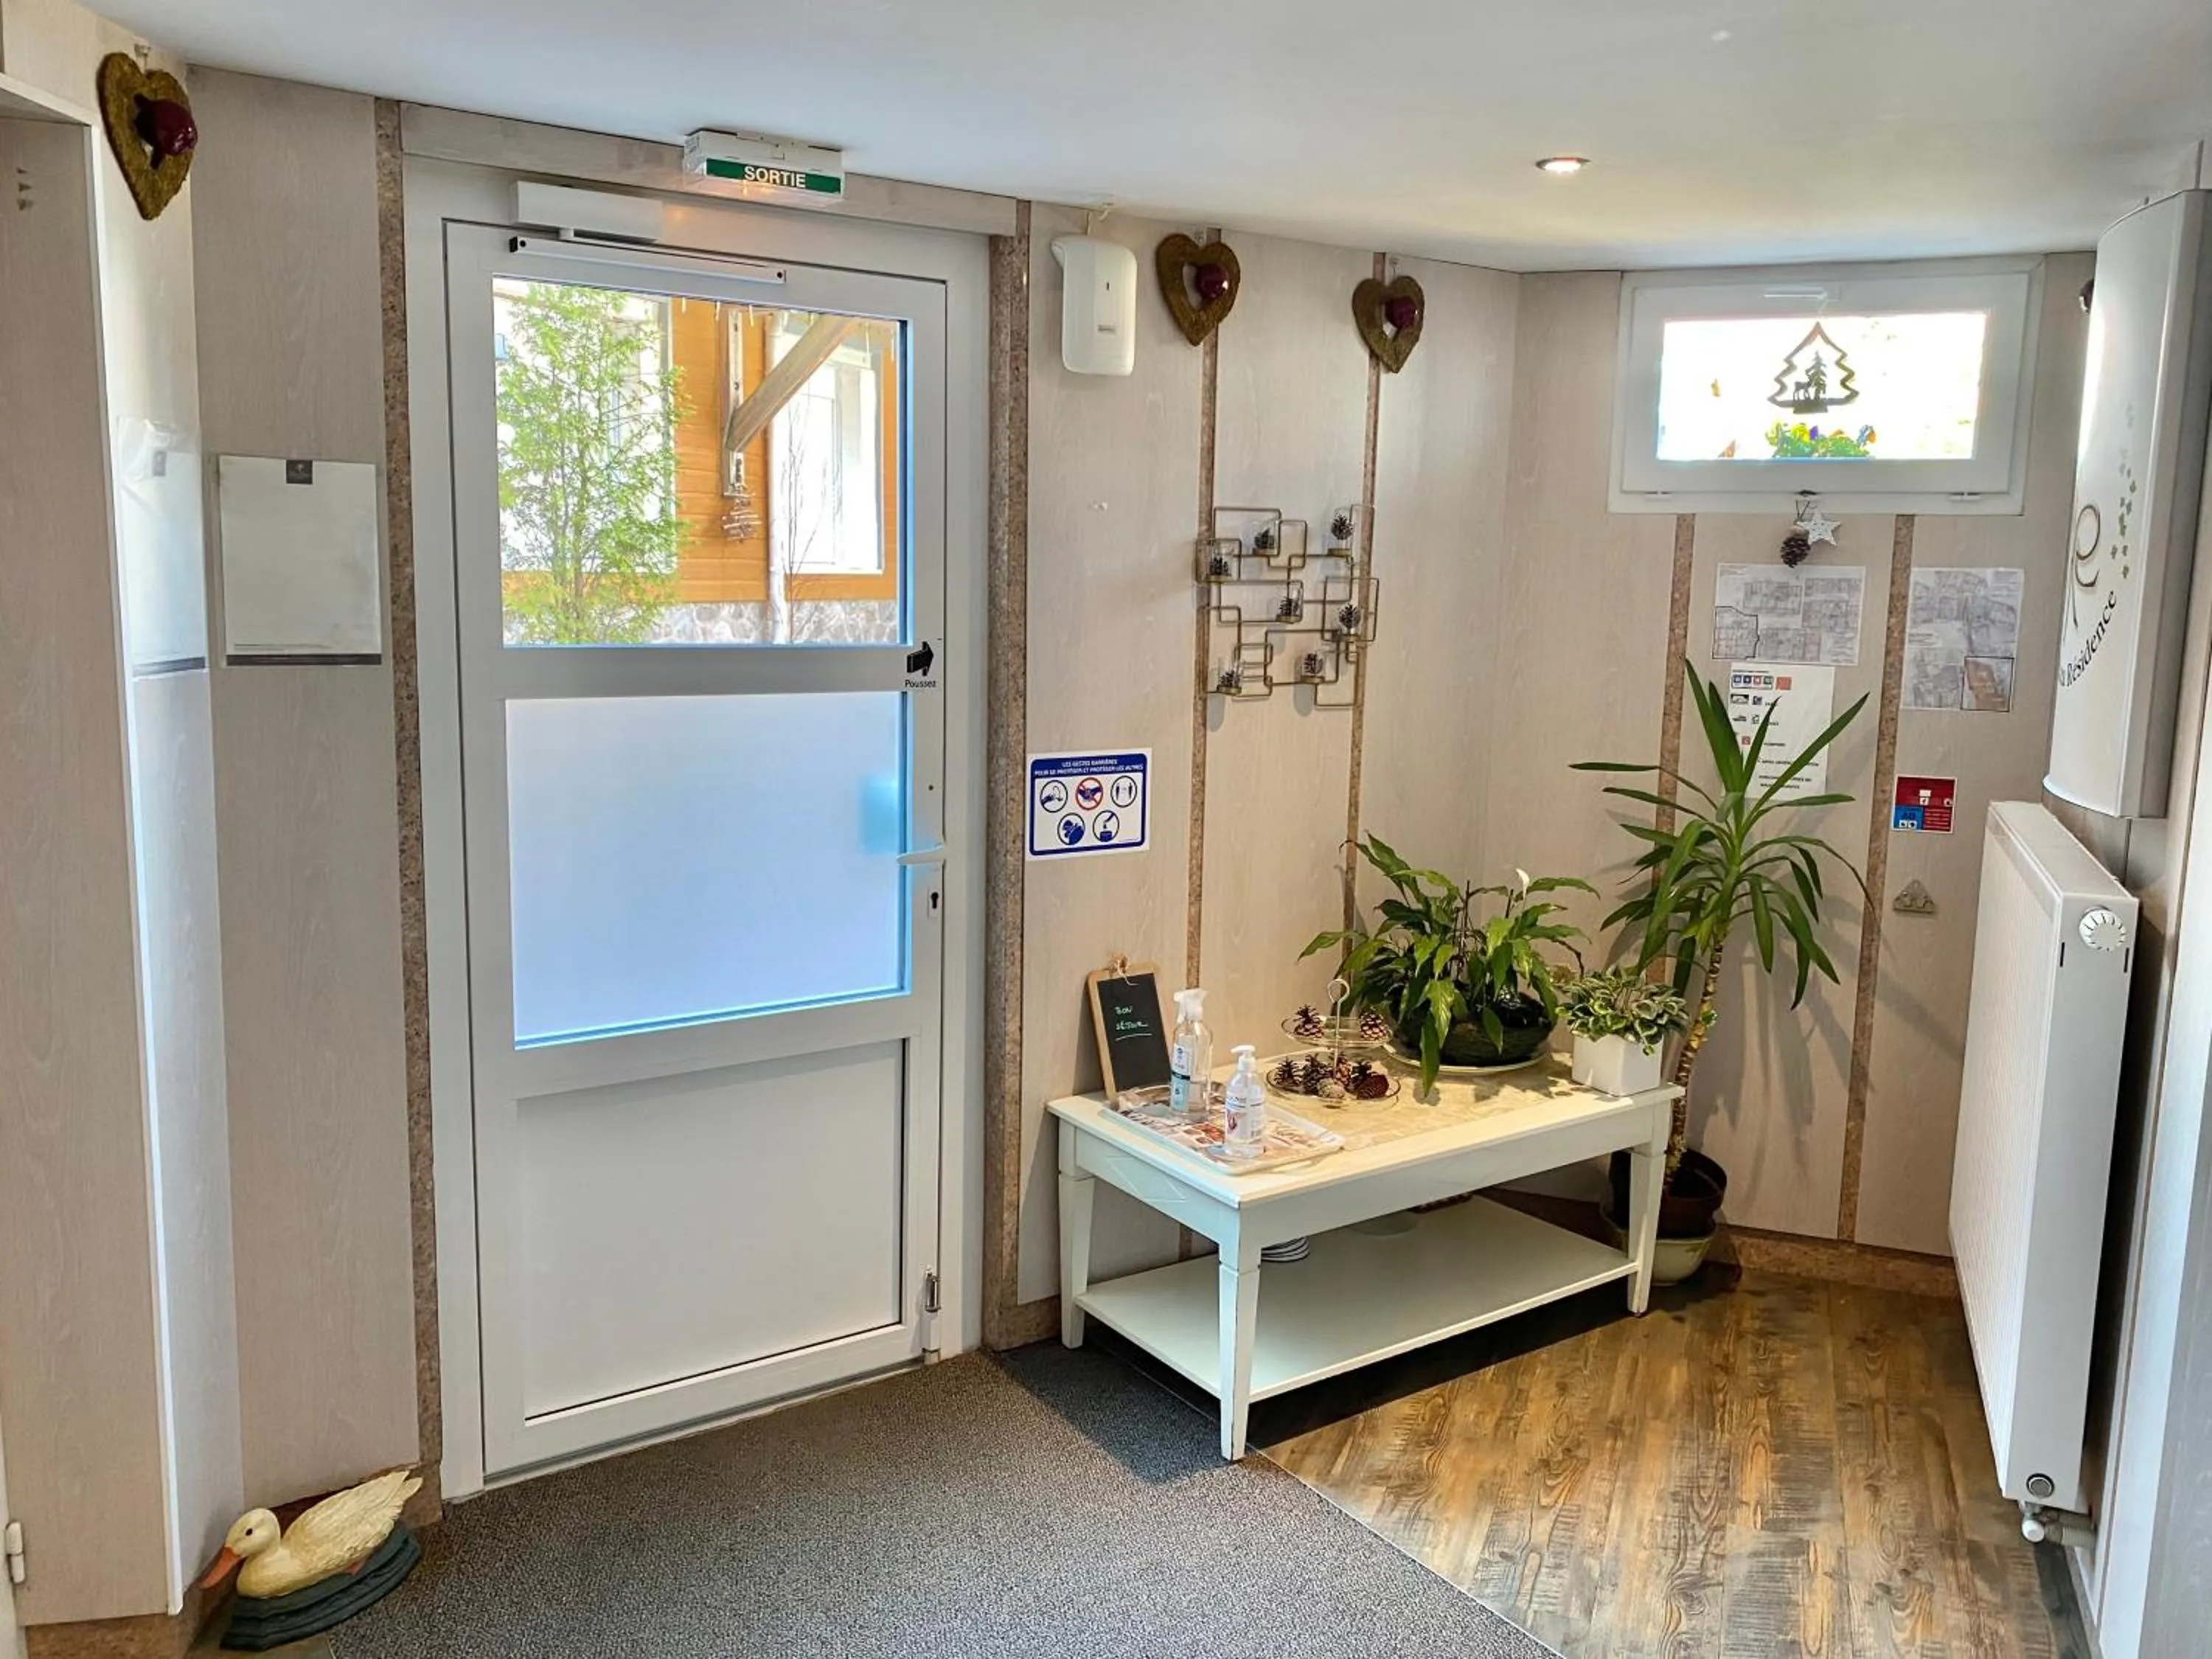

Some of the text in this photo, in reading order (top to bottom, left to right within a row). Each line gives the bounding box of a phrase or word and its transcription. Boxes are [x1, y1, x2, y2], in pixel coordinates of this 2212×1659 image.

[744, 166, 807, 189] SORTIE
[2067, 590, 2117, 686] Résidence
[905, 679, 936, 688] Poussez
